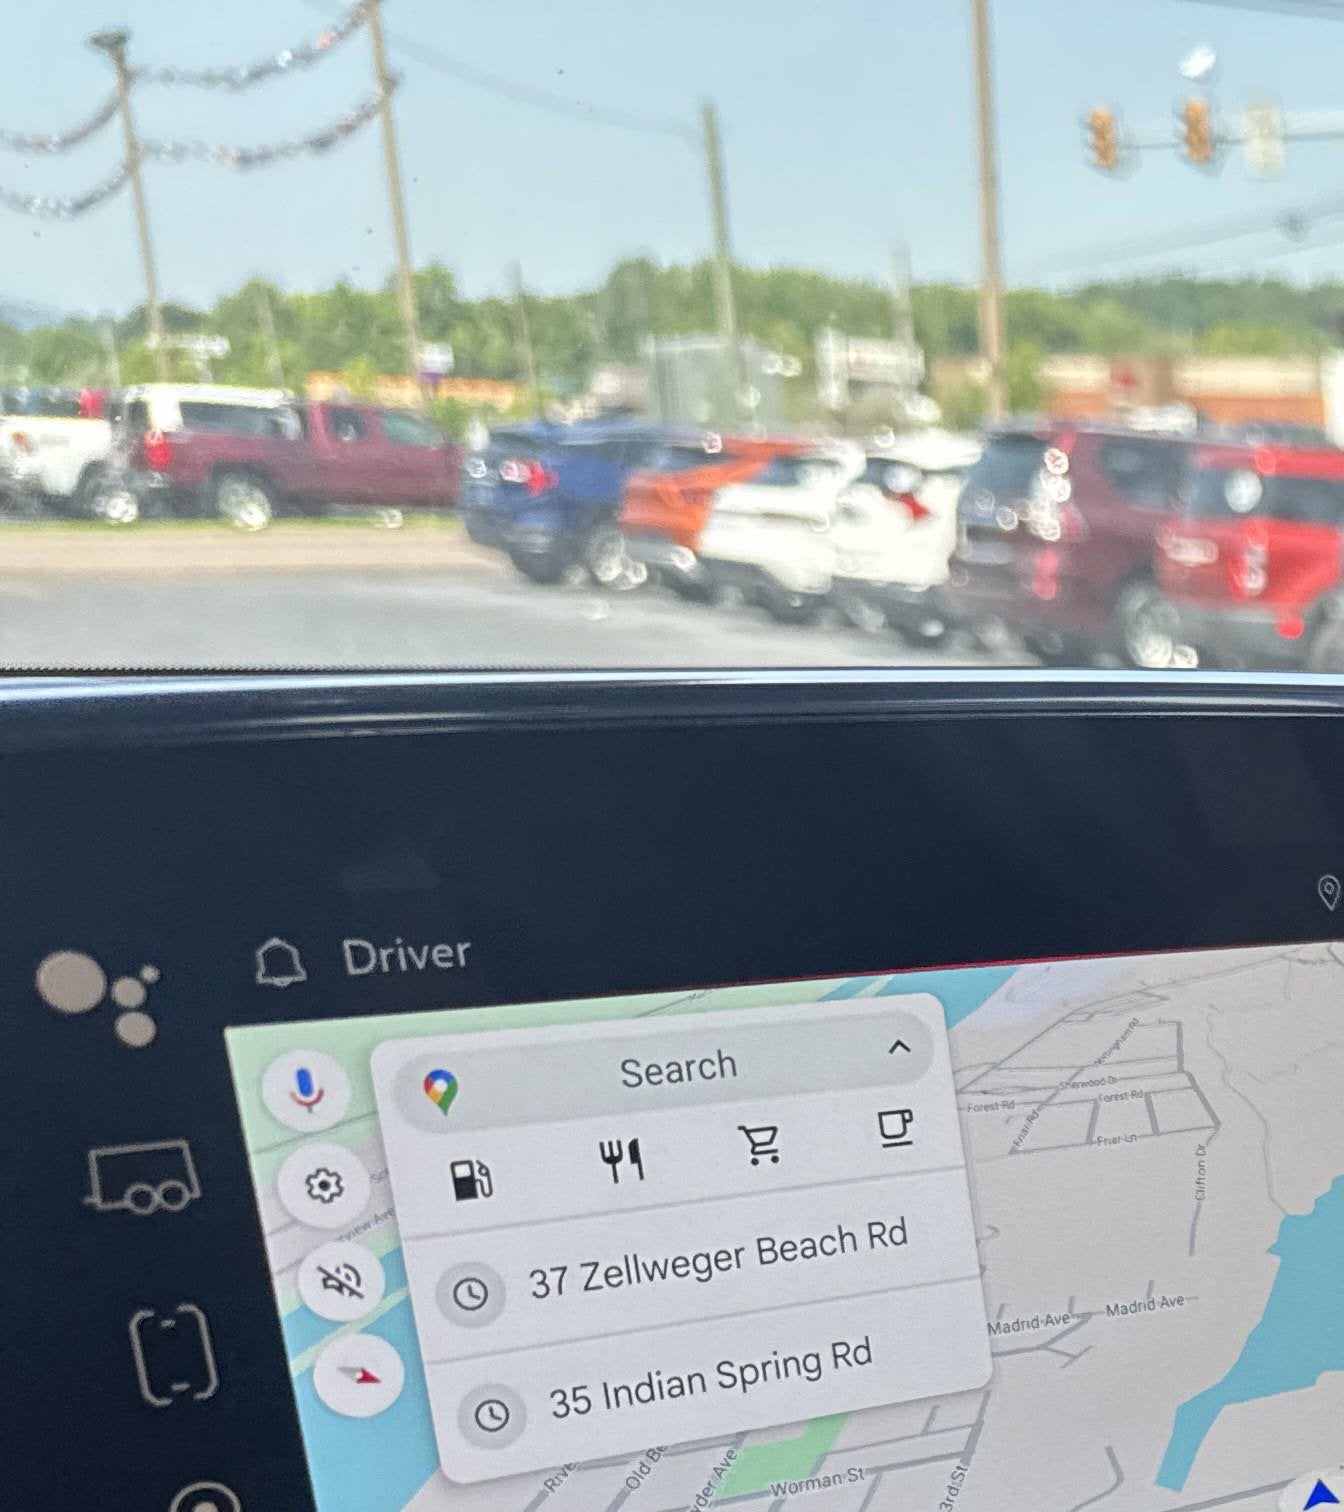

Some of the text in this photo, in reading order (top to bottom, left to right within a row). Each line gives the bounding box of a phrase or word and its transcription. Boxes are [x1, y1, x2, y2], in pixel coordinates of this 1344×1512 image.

[343, 937, 471, 976] Driver
[619, 1050, 738, 1088] Search
[967, 1100, 1015, 1113] Forest Rd
[1099, 1089, 1144, 1103] Forest Rd
[1195, 1160, 1206, 1201] Clifton
[528, 1215, 909, 1299] 37 Zellweger Beach Rd
[1106, 1295, 1185, 1317] Madrid Ave
[987, 1312, 1071, 1336] Madrid Ave
[550, 1335, 873, 1419] 35 Indian Spring Rd
[625, 1461, 651, 1490] Old
[712, 1449, 738, 1479] Ave
[952, 1465, 969, 1482] St
[770, 1467, 866, 1498] Worman St
